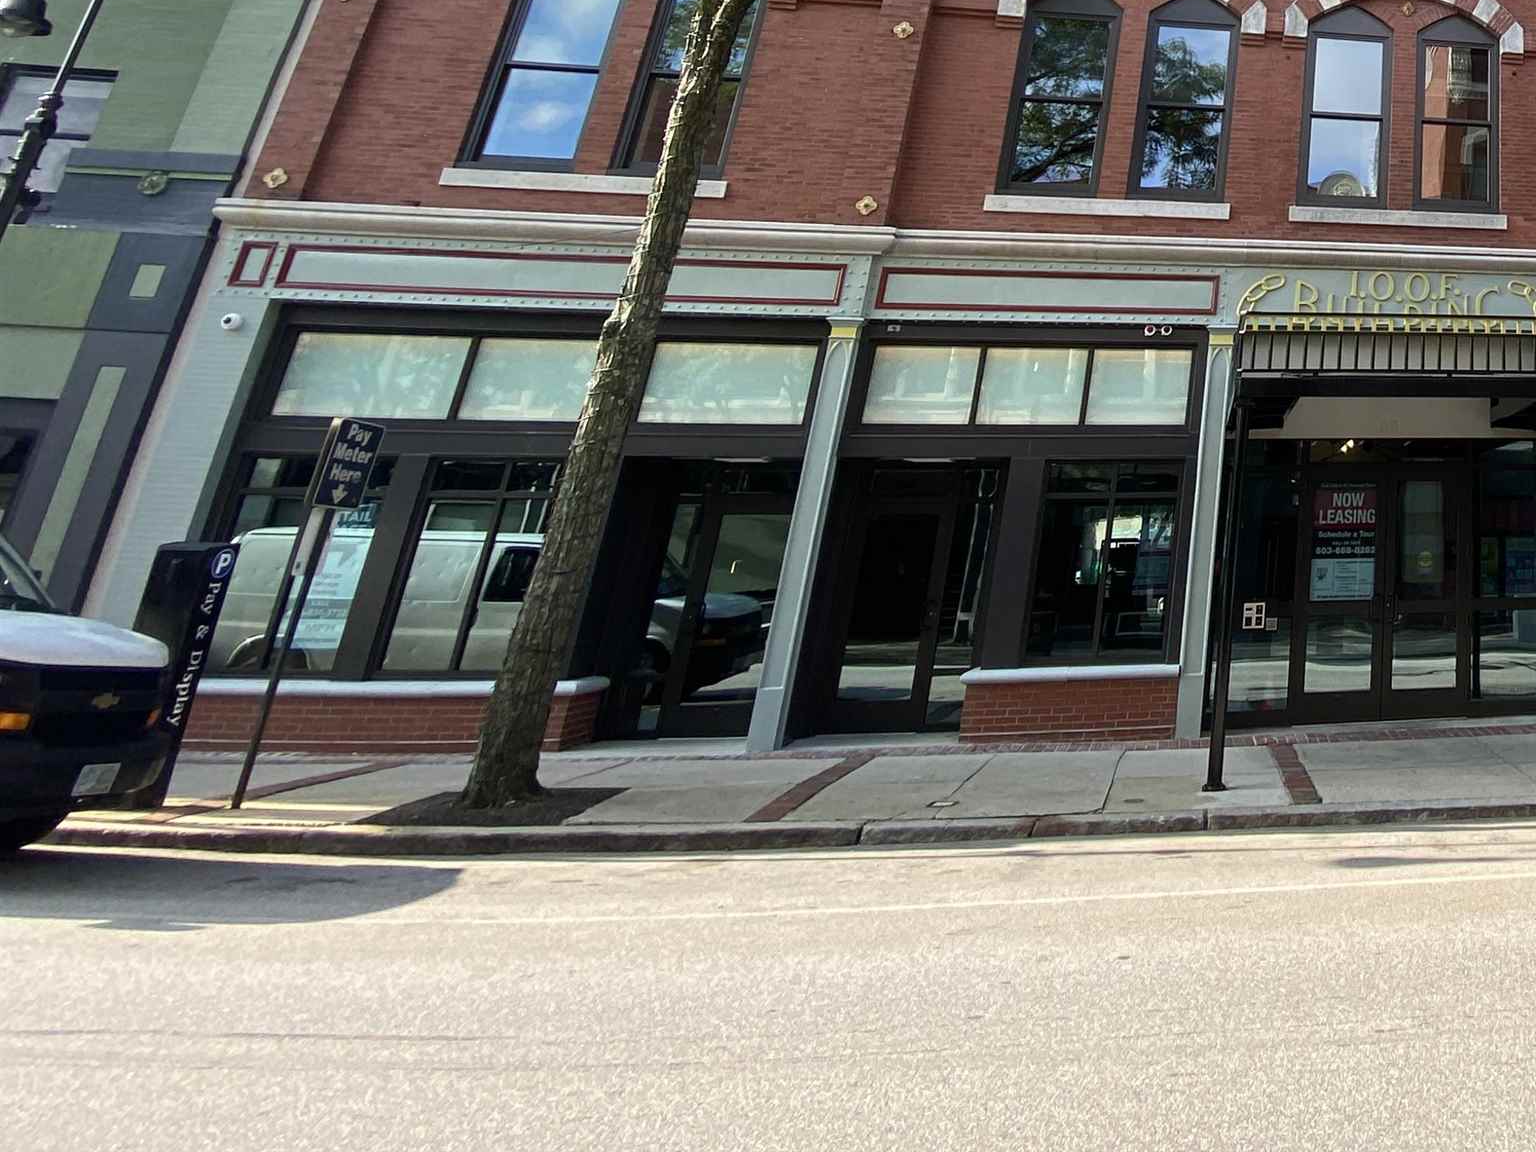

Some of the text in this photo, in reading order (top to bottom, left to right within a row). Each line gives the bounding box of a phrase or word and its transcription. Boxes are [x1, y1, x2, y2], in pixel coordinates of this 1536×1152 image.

[1349, 270, 1462, 302] I.O.O.F.
[347, 423, 373, 447] Pay
[333, 442, 373, 464] Meter
[329, 463, 362, 482] Here
[1333, 492, 1365, 508] NOW
[1319, 509, 1377, 525] LEASING
[214, 553, 232, 575] P
[166, 581, 223, 727] Pay & Display
